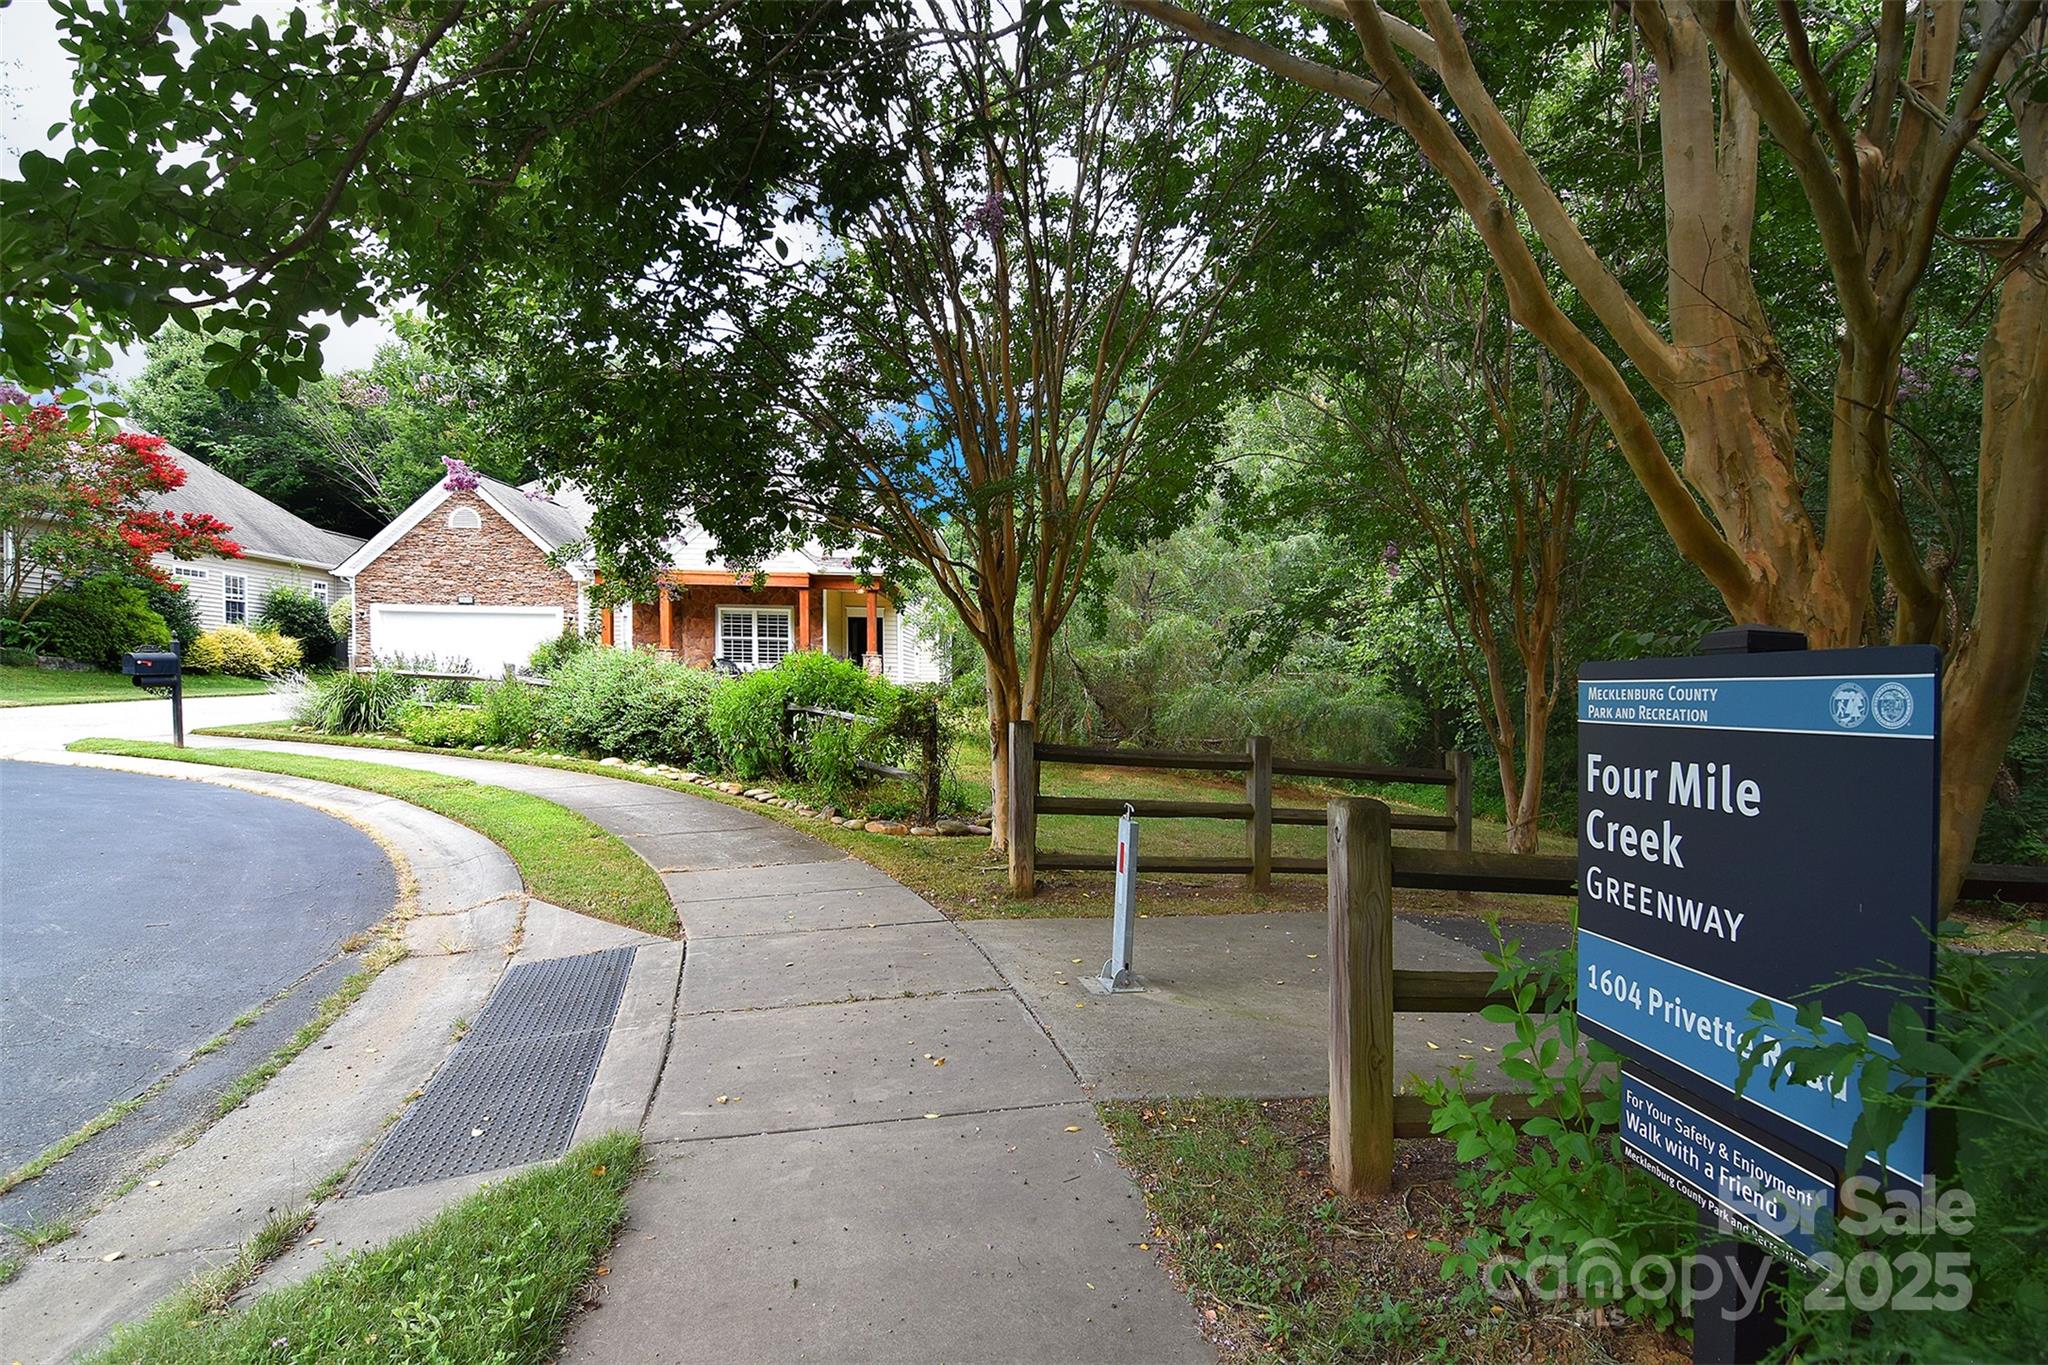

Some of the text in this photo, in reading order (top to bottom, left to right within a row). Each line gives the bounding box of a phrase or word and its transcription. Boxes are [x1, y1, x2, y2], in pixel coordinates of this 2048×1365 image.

[1588, 685, 1718, 702] MECKLENBURG COUNTY
[1588, 704, 1708, 722] PARK AND RECREATION
[1587, 753, 1761, 817] Four Mile
[1586, 809, 1685, 868] Creek
[1586, 866, 1744, 943] GREENWAY
[1587, 964, 1642, 1011] 1604
[1625, 1109, 1778, 1219] Walk with a Friend
[1626, 1089, 1813, 1206] For Your Safety & Enjoyment
[1624, 1146, 1675, 1188] Mecklenburg
[1676, 1180, 1707, 1208] County
[1708, 1200, 1730, 1222] Park
[1730, 1217, 1749, 1234] and
